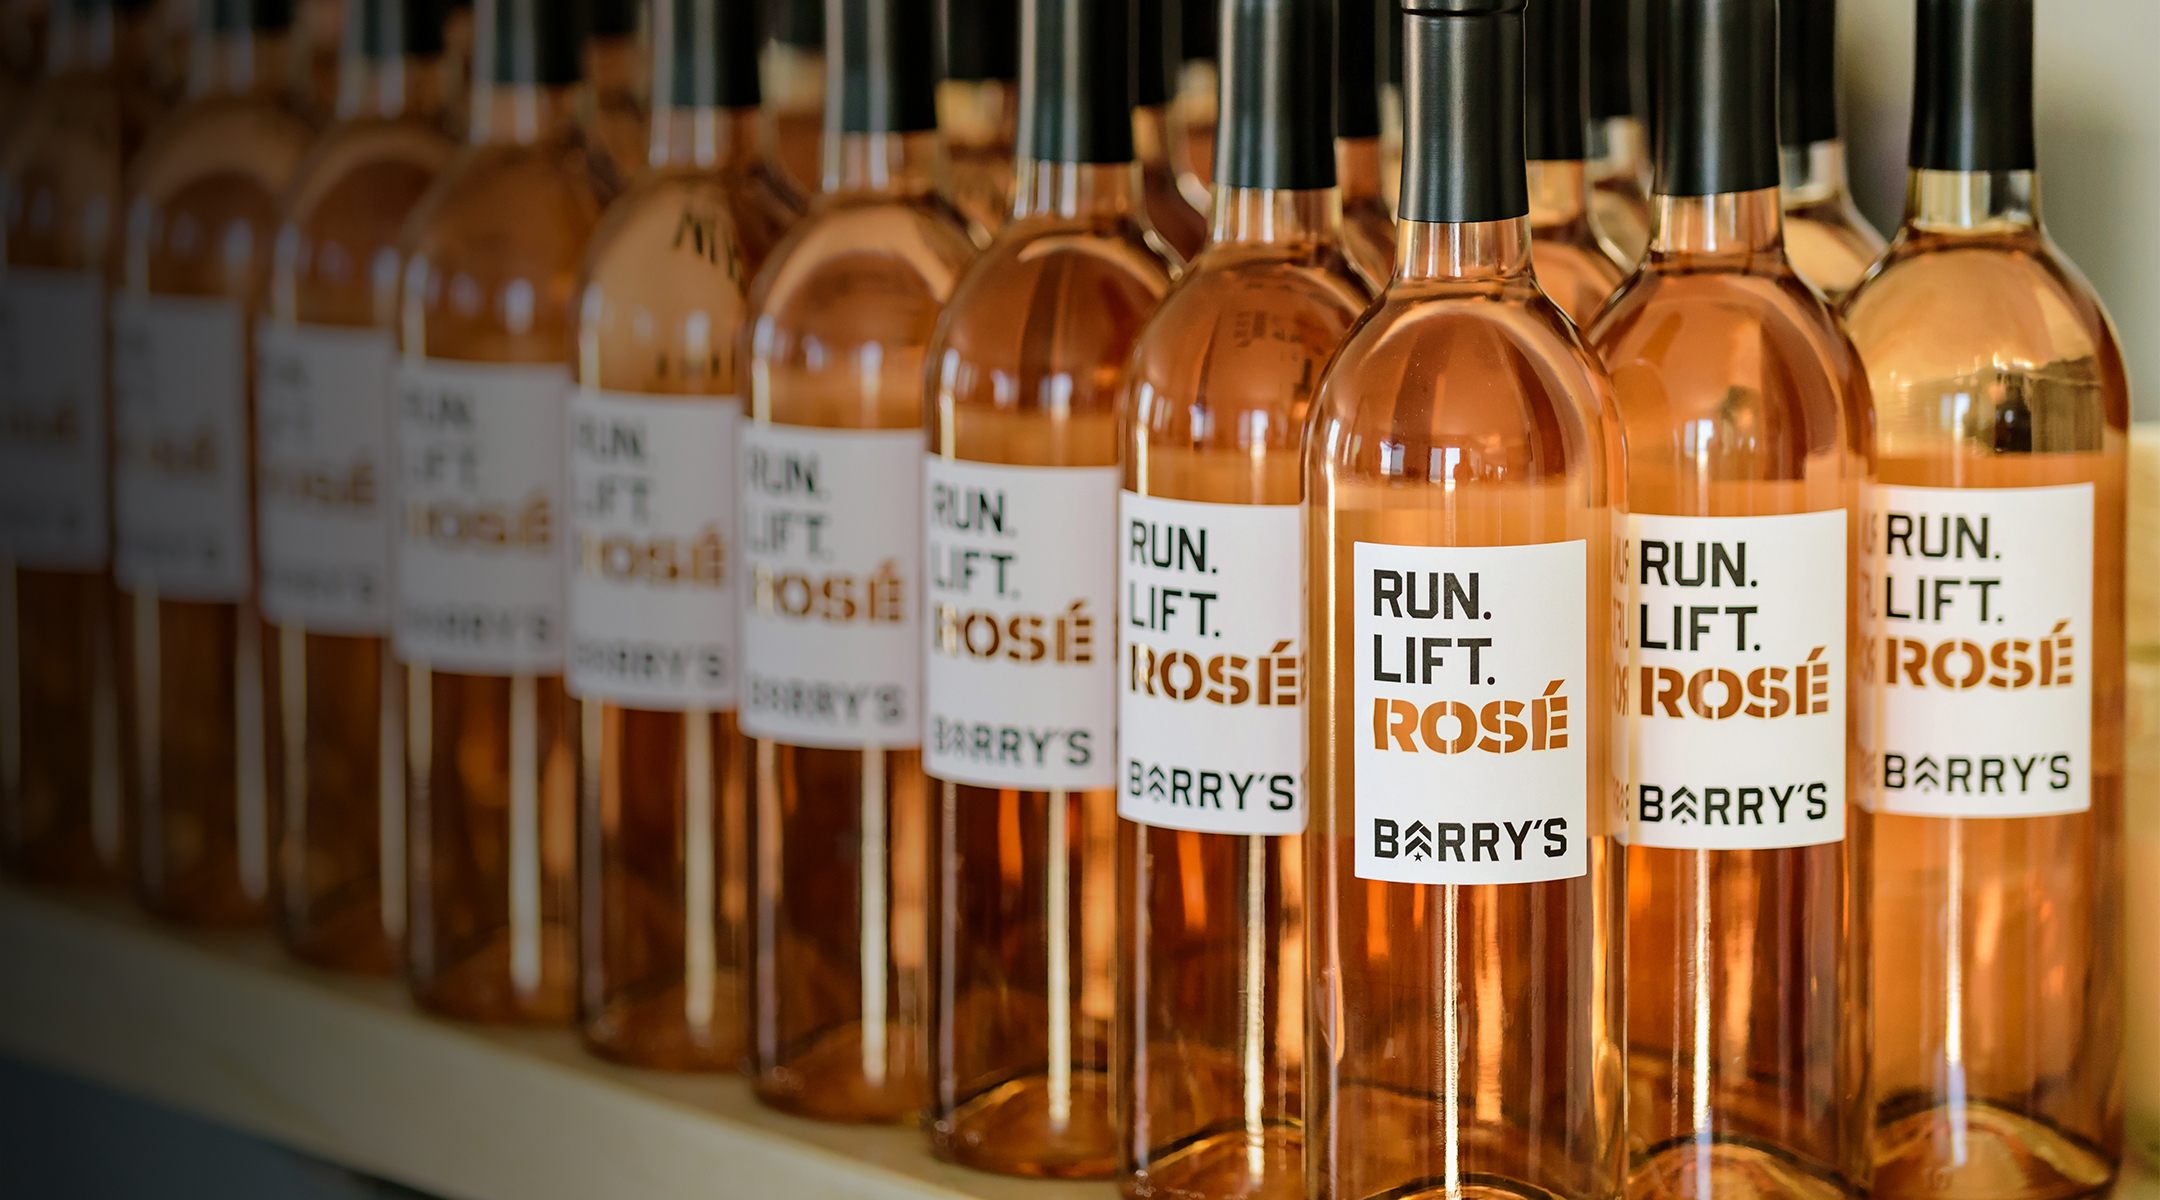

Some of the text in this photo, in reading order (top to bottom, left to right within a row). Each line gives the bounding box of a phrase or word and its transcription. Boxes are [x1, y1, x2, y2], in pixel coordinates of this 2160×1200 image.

[932, 482, 1016, 537] RUN.
[1130, 520, 1218, 574] RUN.
[1886, 513, 2001, 560] RUN.
[933, 545, 1020, 600] LIFT.
[1639, 540, 1758, 589] RUN.
[1130, 585, 1221, 638] LIFT.
[1373, 569, 1492, 620] RUN.
[1886, 576, 2004, 623] LIFT.
[1639, 603, 1762, 653] LIFT.
[1886, 619, 2074, 689] ROSÉ
[1130, 640, 1298, 706] ROSÉ
[1373, 634, 1496, 686] LIFT.
[1640, 646, 1829, 719] ROSÉ
[1373, 679, 1568, 755] ROSÉ
